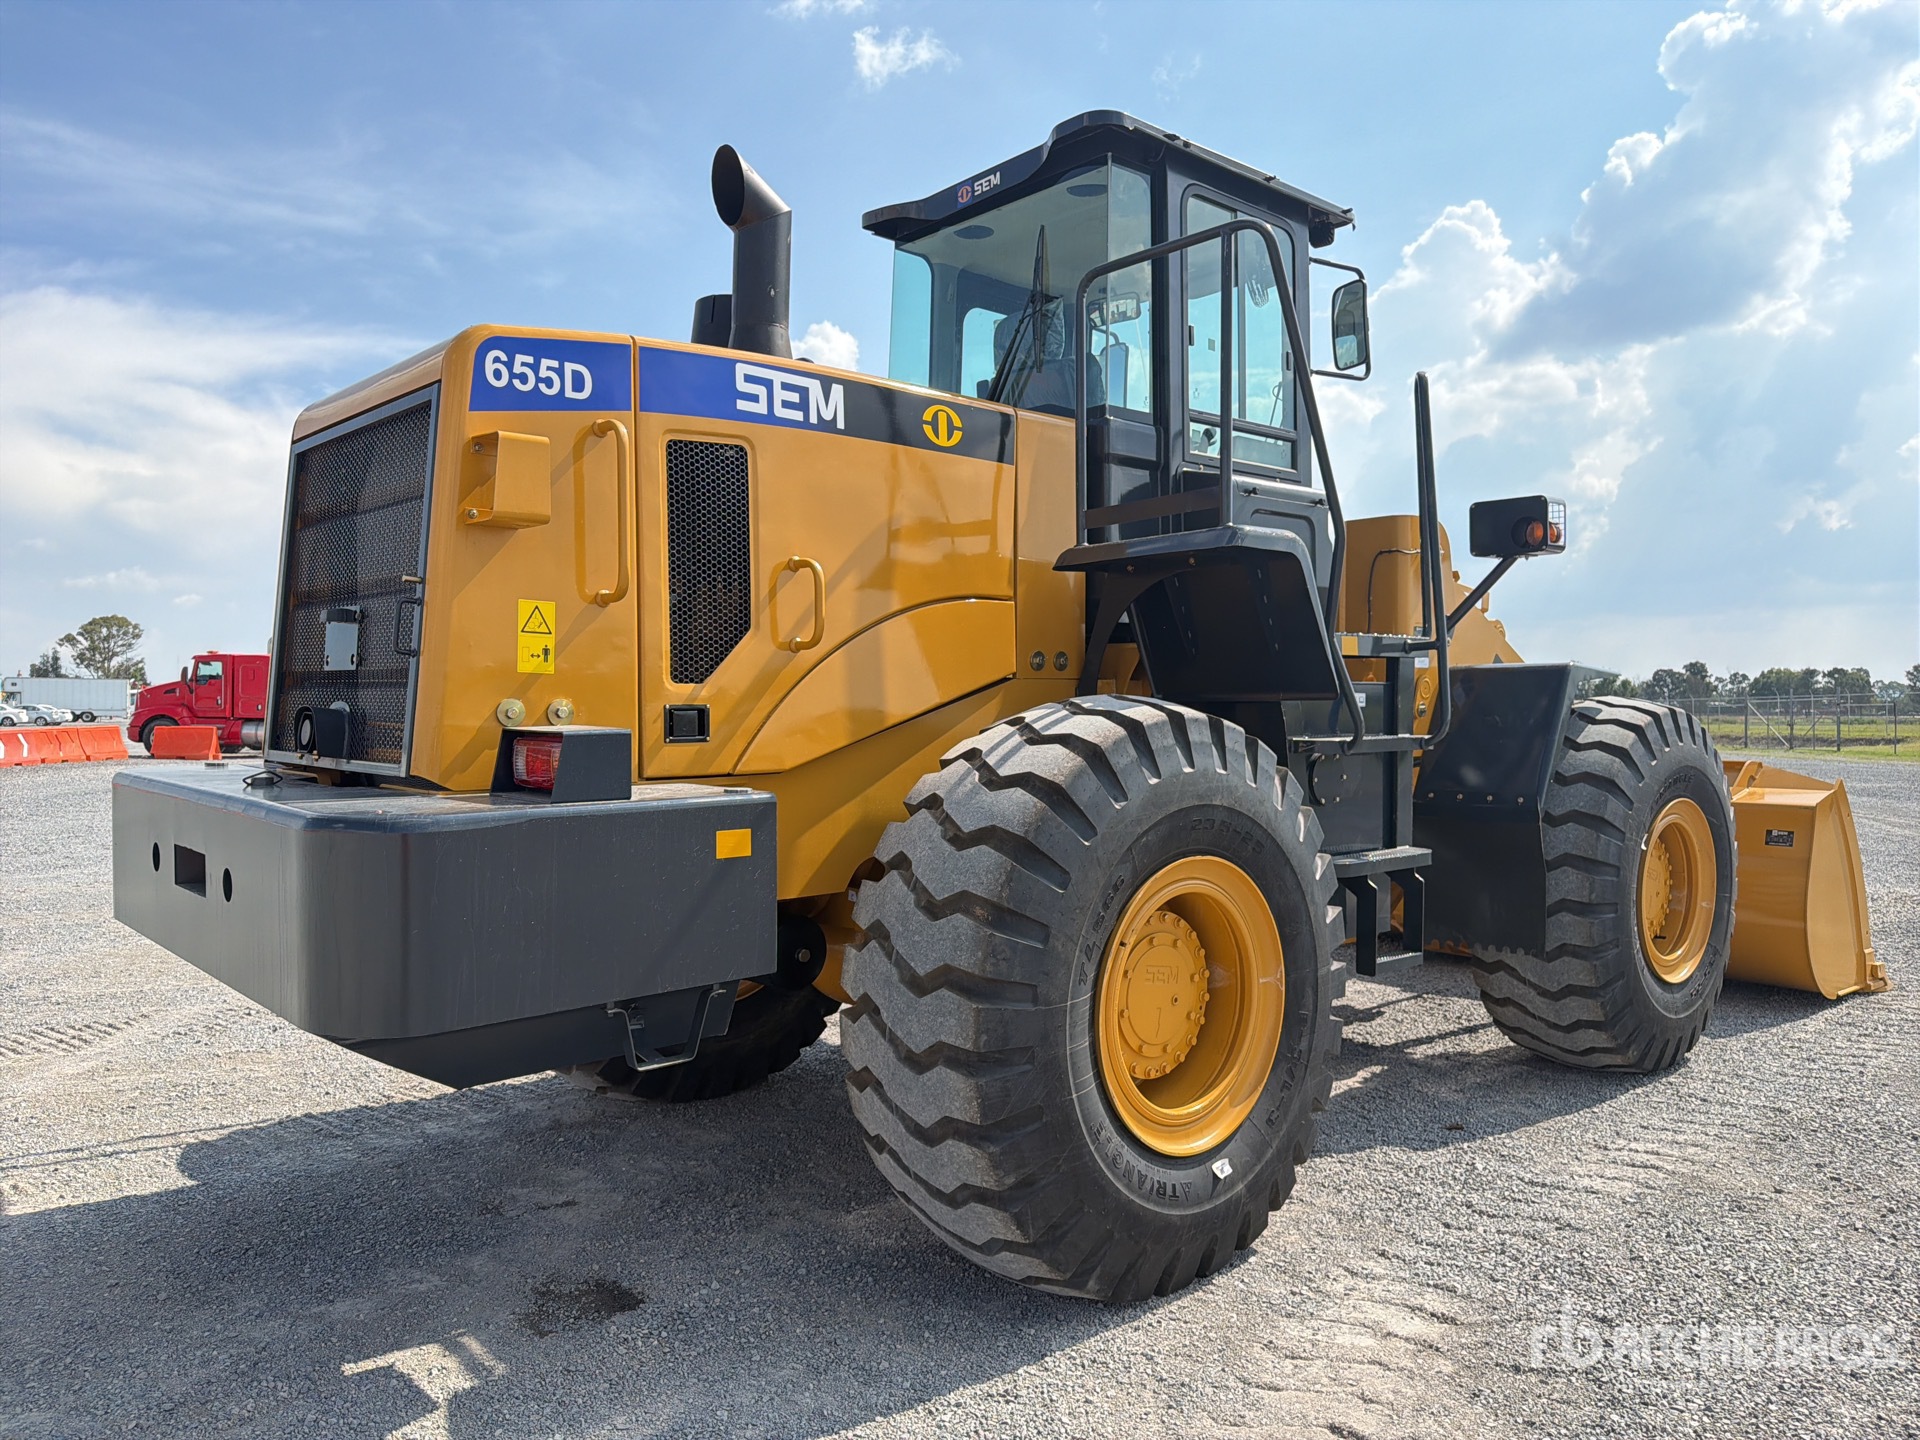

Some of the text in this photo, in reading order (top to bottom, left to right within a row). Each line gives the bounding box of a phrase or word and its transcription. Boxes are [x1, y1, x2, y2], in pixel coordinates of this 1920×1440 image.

[974, 171, 1000, 196] SEM
[485, 349, 593, 400] 655D
[735, 362, 845, 430] SEM
[1144, 964, 1180, 985] SEM
[1092, 1119, 1180, 1202] TRIANGLE
